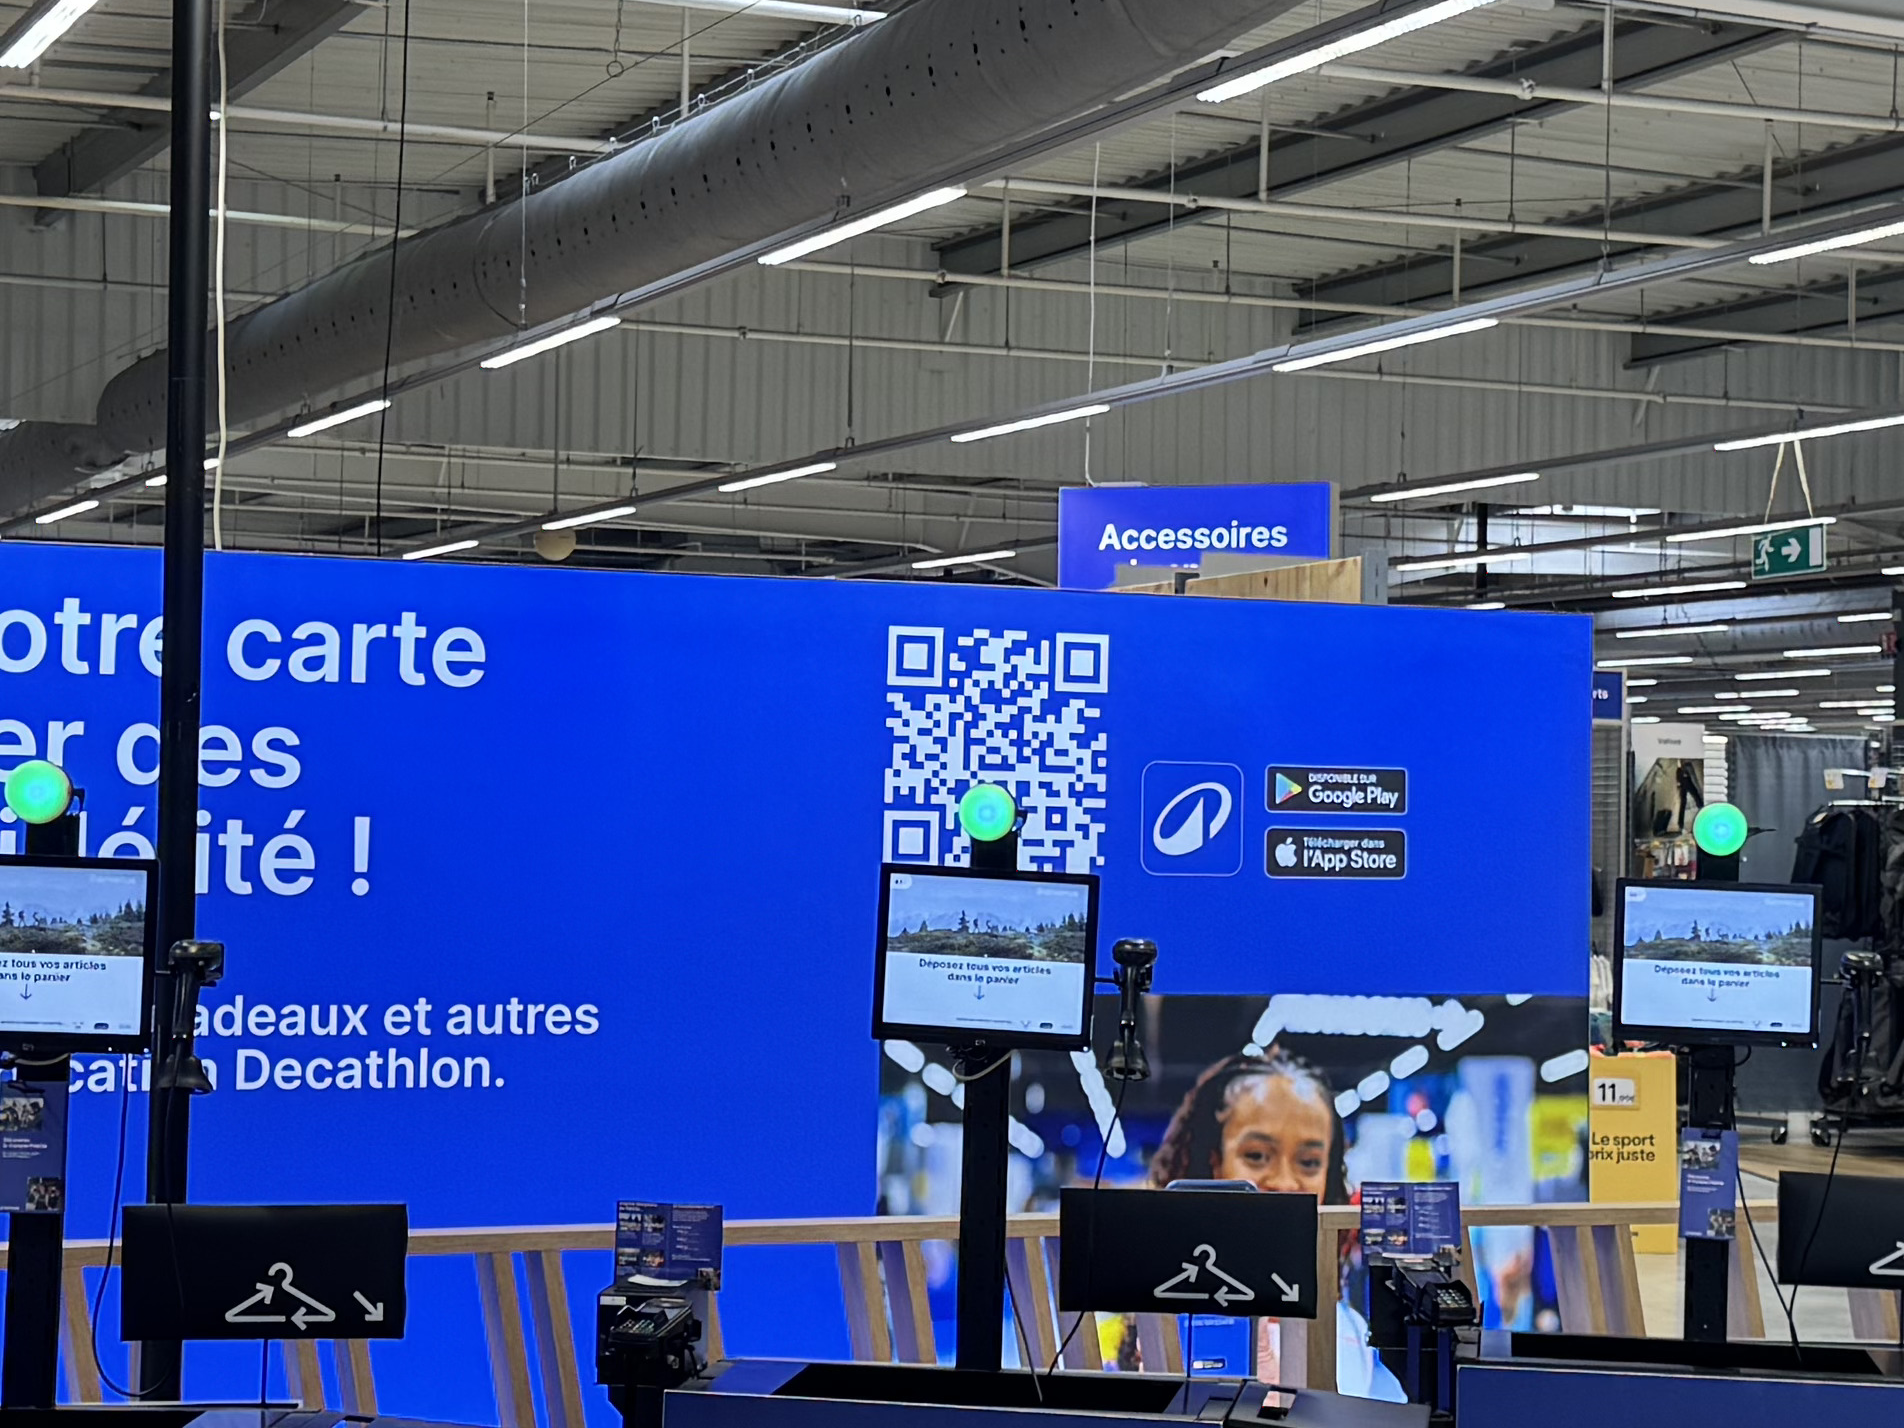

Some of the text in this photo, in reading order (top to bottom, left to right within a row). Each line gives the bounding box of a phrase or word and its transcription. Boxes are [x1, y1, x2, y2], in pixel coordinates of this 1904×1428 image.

[1098, 519, 1288, 551] Accessoires
[227, 611, 486, 688] carte
[1308, 784, 1399, 809] Google Play
[1303, 836, 1386, 850] Télécharger dans
[351, 816, 371, 896] !
[1303, 849, 1397, 872] l'App Store
[11, 959, 37, 969] tous
[40, 961, 60, 970] vos
[194, 994, 369, 1038] adeaux
[383, 997, 432, 1036] et
[446, 997, 599, 1036] autres
[235, 1047, 505, 1090] Decathlon.
[1591, 1131, 1656, 1149] Le sport
[1616, 1147, 1656, 1165] juste
